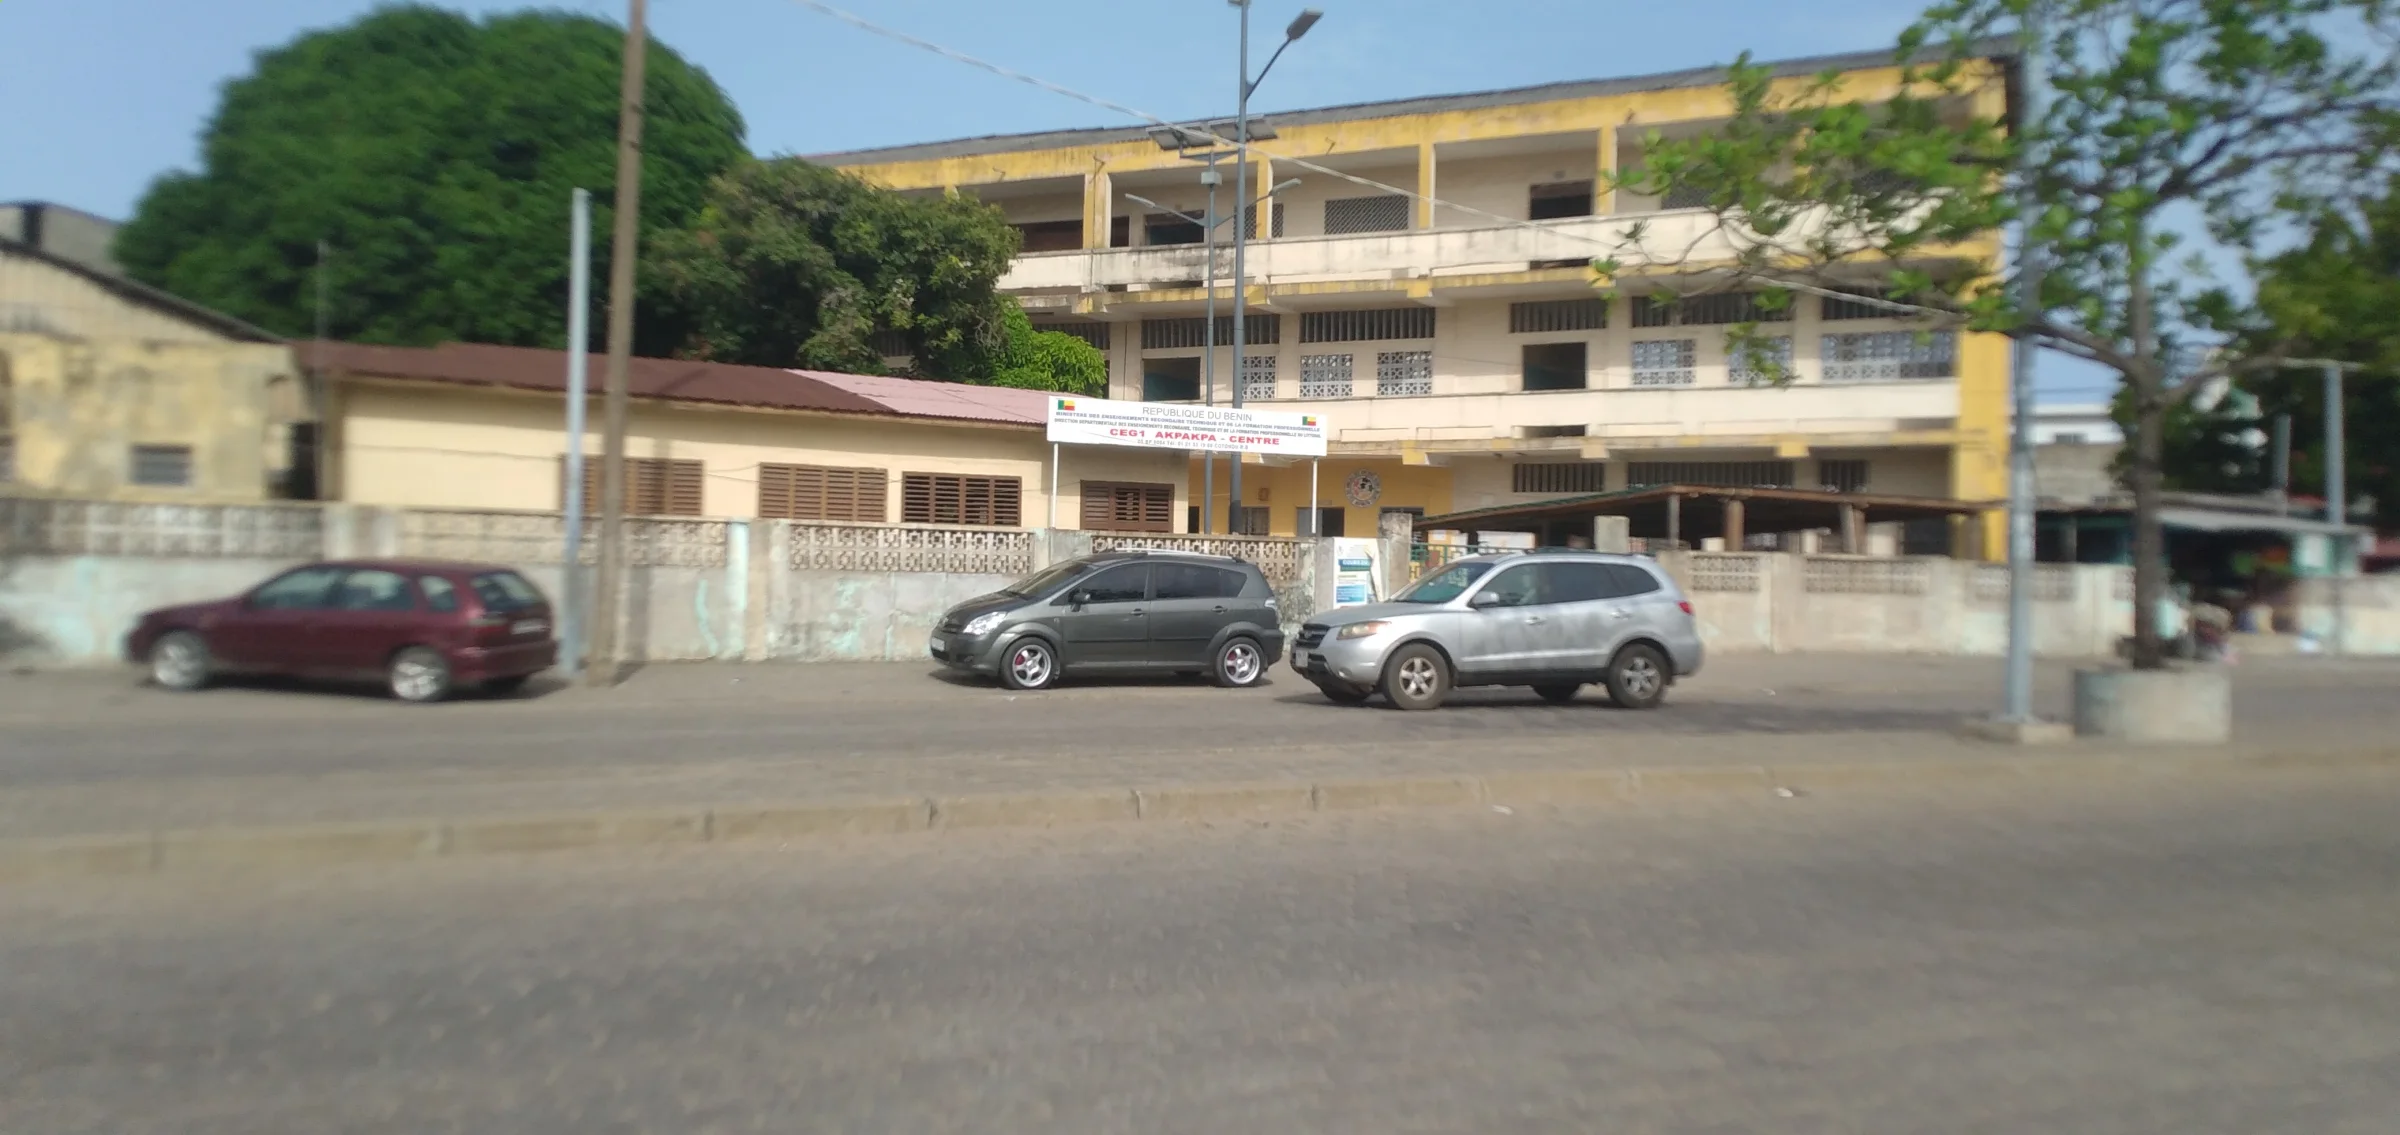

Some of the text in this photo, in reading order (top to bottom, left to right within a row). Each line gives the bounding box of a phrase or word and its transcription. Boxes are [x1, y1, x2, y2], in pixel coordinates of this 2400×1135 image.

[1142, 406, 1252, 421] REPUBLIQUE DU BENIN
[1110, 428, 1144, 437] CEG1
[1155, 430, 1217, 442] AKPAKPA
[1229, 435, 1280, 446] CENTRE
